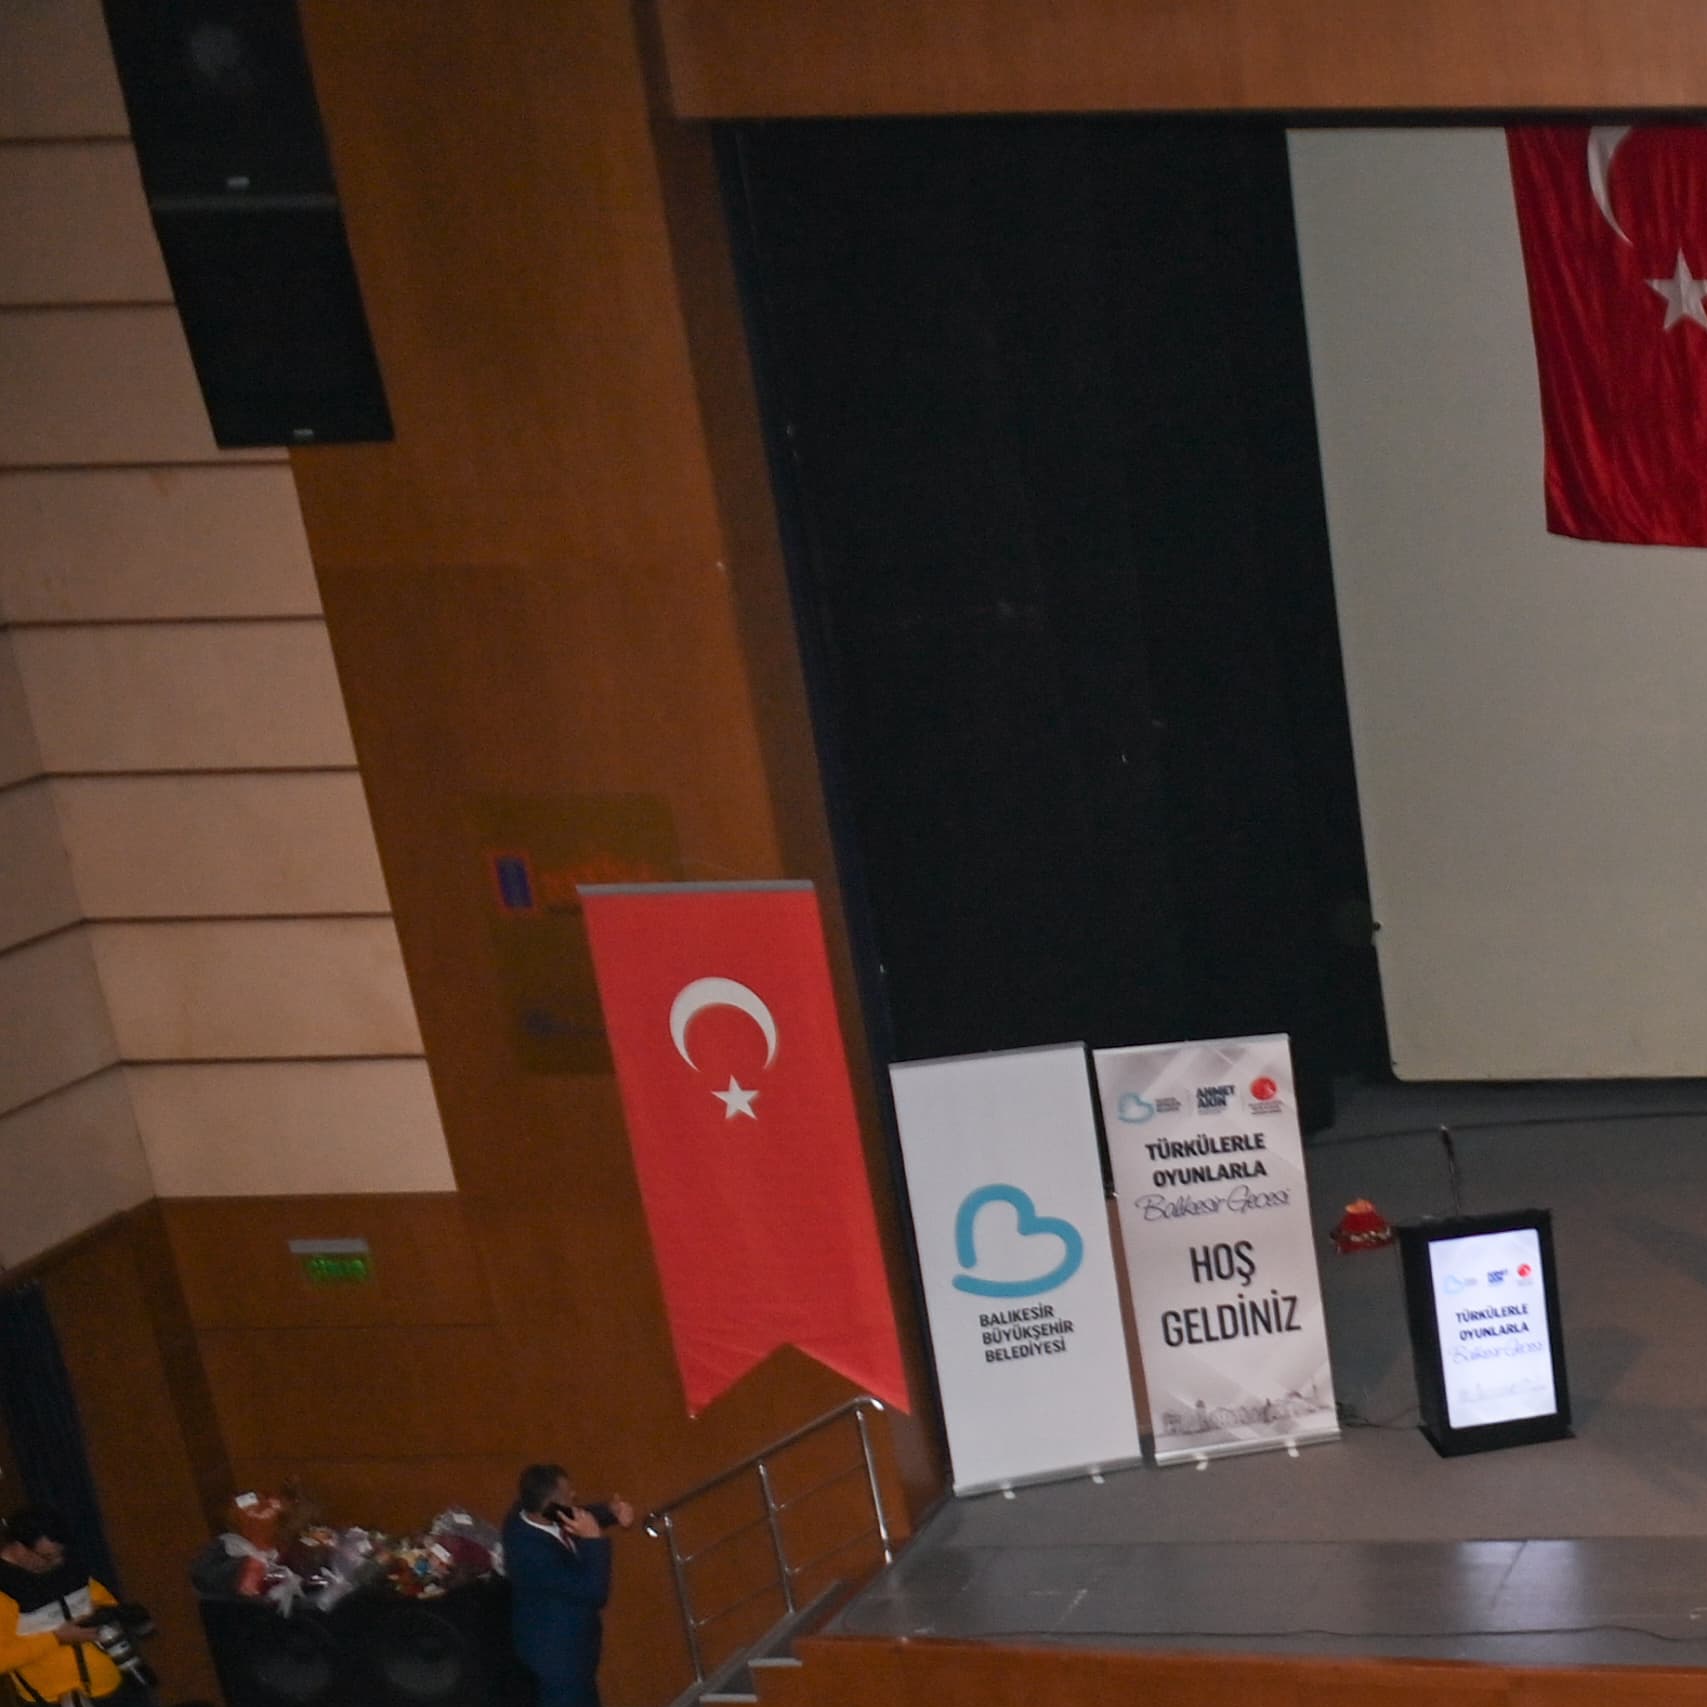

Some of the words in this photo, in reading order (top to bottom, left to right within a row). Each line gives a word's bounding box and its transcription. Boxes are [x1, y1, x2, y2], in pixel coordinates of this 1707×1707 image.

[1144, 1132, 1267, 1161] TÜRKÜLERLE
[1152, 1159, 1268, 1188] OYUNLARLA
[1189, 1240, 1257, 1287] HOŞ
[978, 1301, 1055, 1328] BALIKESİR
[1160, 1288, 1303, 1348] GELDİNİZ
[981, 1317, 1075, 1346] BÜYÜKŞEHİR
[1459, 1320, 1530, 1341] OYUNLARLA
[984, 1335, 1067, 1363] BELEDİYESİ
